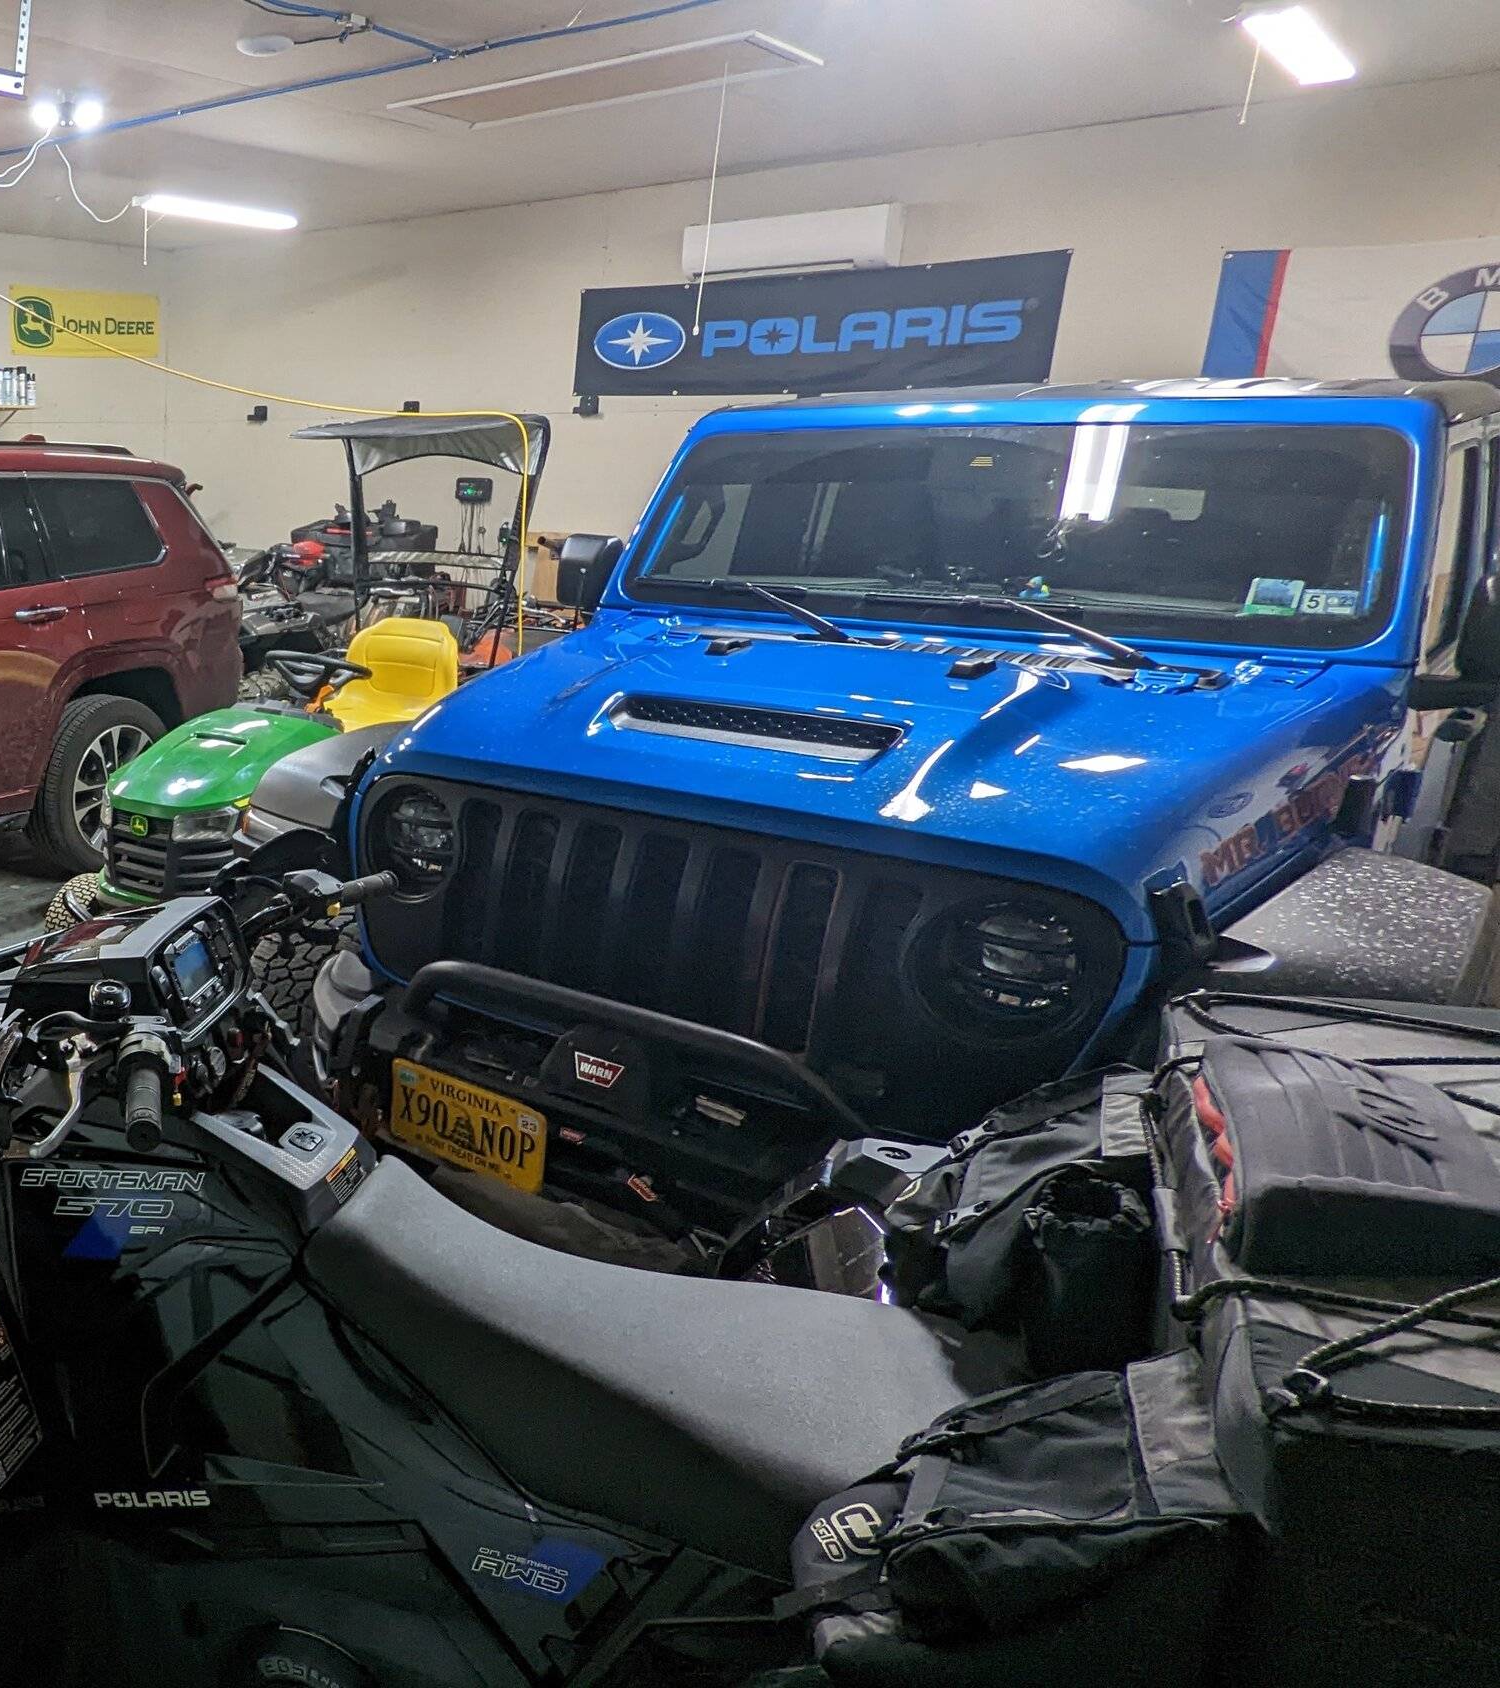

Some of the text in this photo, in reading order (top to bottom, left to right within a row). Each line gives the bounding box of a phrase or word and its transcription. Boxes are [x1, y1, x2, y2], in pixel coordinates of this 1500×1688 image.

[56, 315, 155, 335] JOHN DEERE
[701, 298, 1023, 357] POLARIS
[1306, 595, 1320, 609] 5
[579, 1061, 613, 1080] WARN
[430, 1079, 502, 1117] VIRGINIA
[400, 1084, 536, 1169] X90 NOP
[20, 1168, 205, 1191] SPORTSMAN
[53, 1196, 175, 1219] 570
[129, 1225, 165, 1235] EFI
[94, 1490, 210, 1508] POLARIS
[479, 1546, 569, 1577] ON DEMAND
[471, 1554, 567, 1594] AWD
